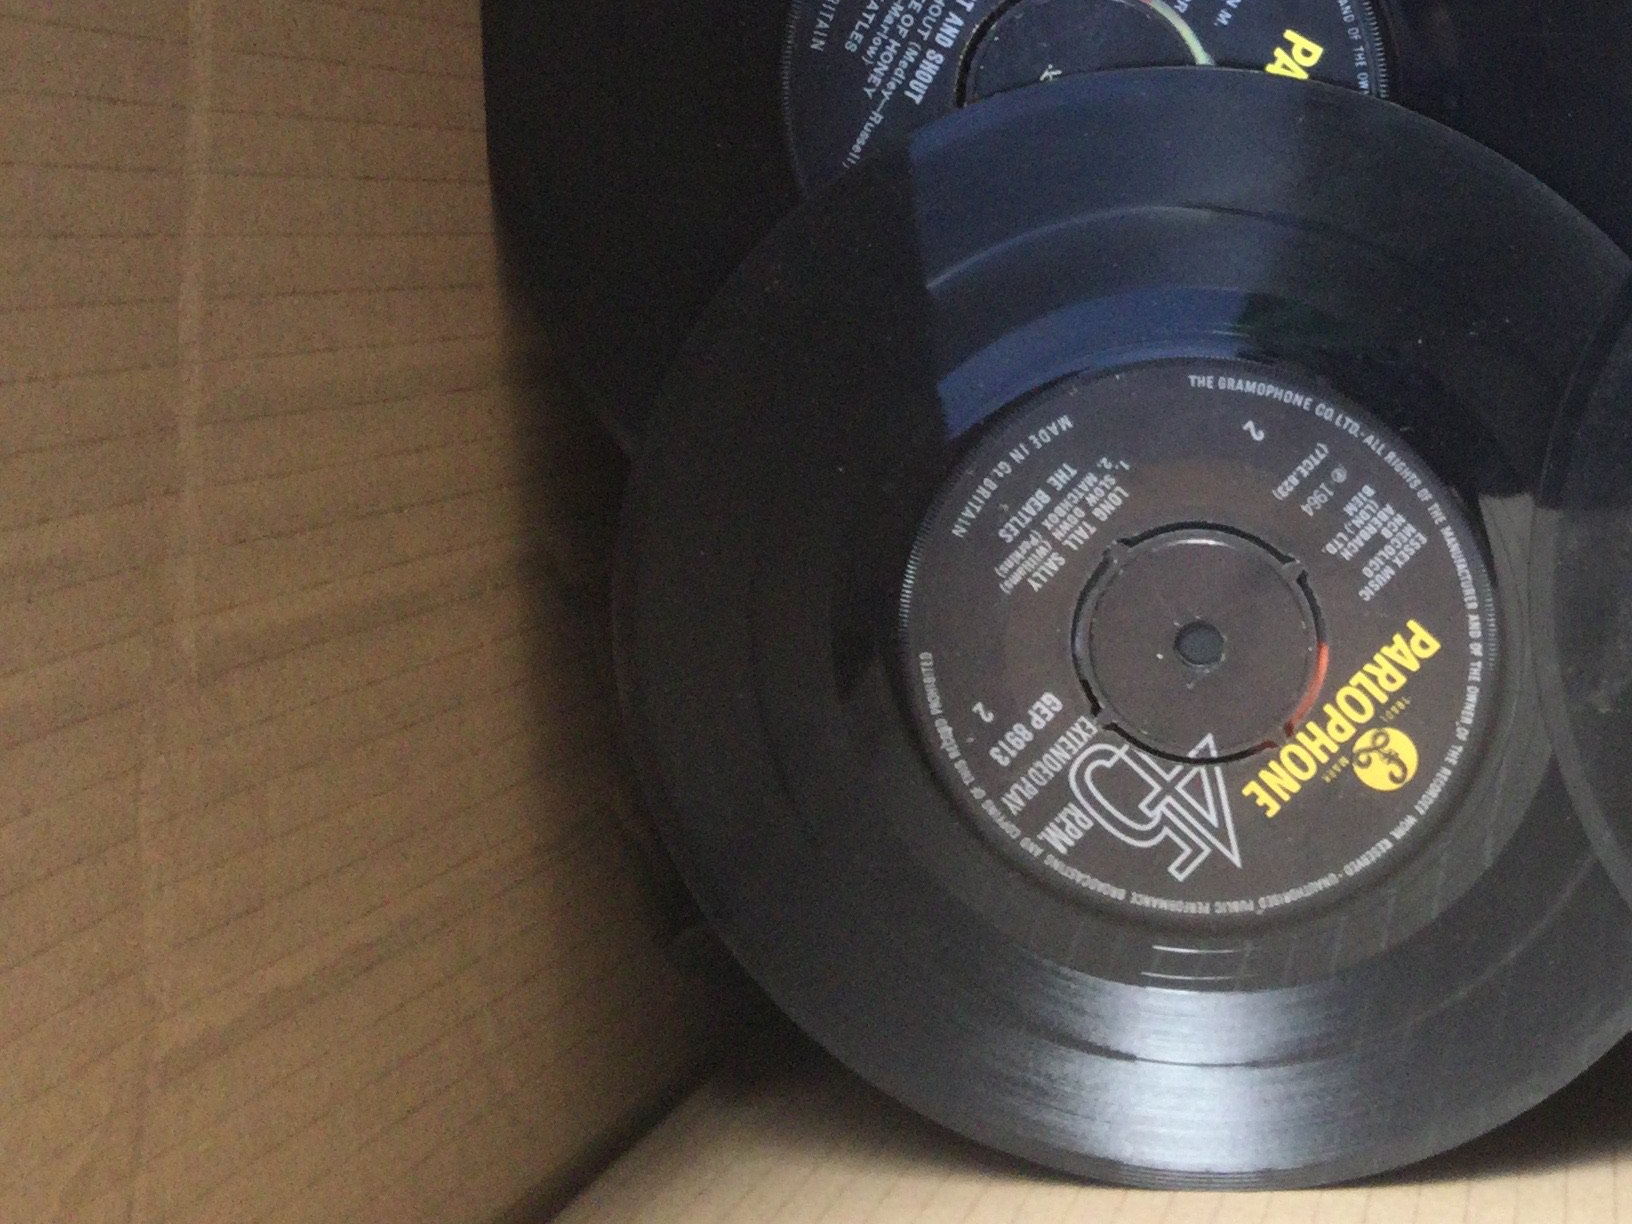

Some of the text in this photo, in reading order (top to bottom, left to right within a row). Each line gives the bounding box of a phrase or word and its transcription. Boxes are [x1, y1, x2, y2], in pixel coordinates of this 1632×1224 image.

[896, 13, 915, 39] OF
[934, 11, 964, 48] AND
[863, 38, 902, 99] HONEY
[904, 48, 945, 105] SHOUT
[1029, 414, 1073, 449] MADE
[1242, 420, 1265, 441] 2
[1008, 443, 1030, 464] IN
[951, 476, 1000, 540] BRITAIN
[998, 462, 1078, 543] THE BEATLES
[1041, 472, 1099, 531] MATCHBOX
[1084, 474, 1116, 507] SLOW
[1188, 374, 1478, 610] THE GRAMOPHONE RIGHTS MANUFACTURER
[1300, 482, 1334, 517] 1964
[1343, 484, 1376, 517] BIEM
[1027, 485, 1129, 592] LONG TALL SALLY
[1051, 506, 1086, 541] DOWN
[1358, 532, 1428, 602] ESSEX MUSIC
[1362, 523, 1417, 579] MECOLICO
[972, 701, 995, 723] 2
[1028, 692, 1063, 730] GEP
[1242, 619, 1441, 819] PARLOPHONE
[989, 722, 1034, 767] 8913
[1027, 715, 1099, 786] EXTENDED
[1001, 776, 1039, 816] PLAY
[1036, 802, 1094, 855] R.P.M.
